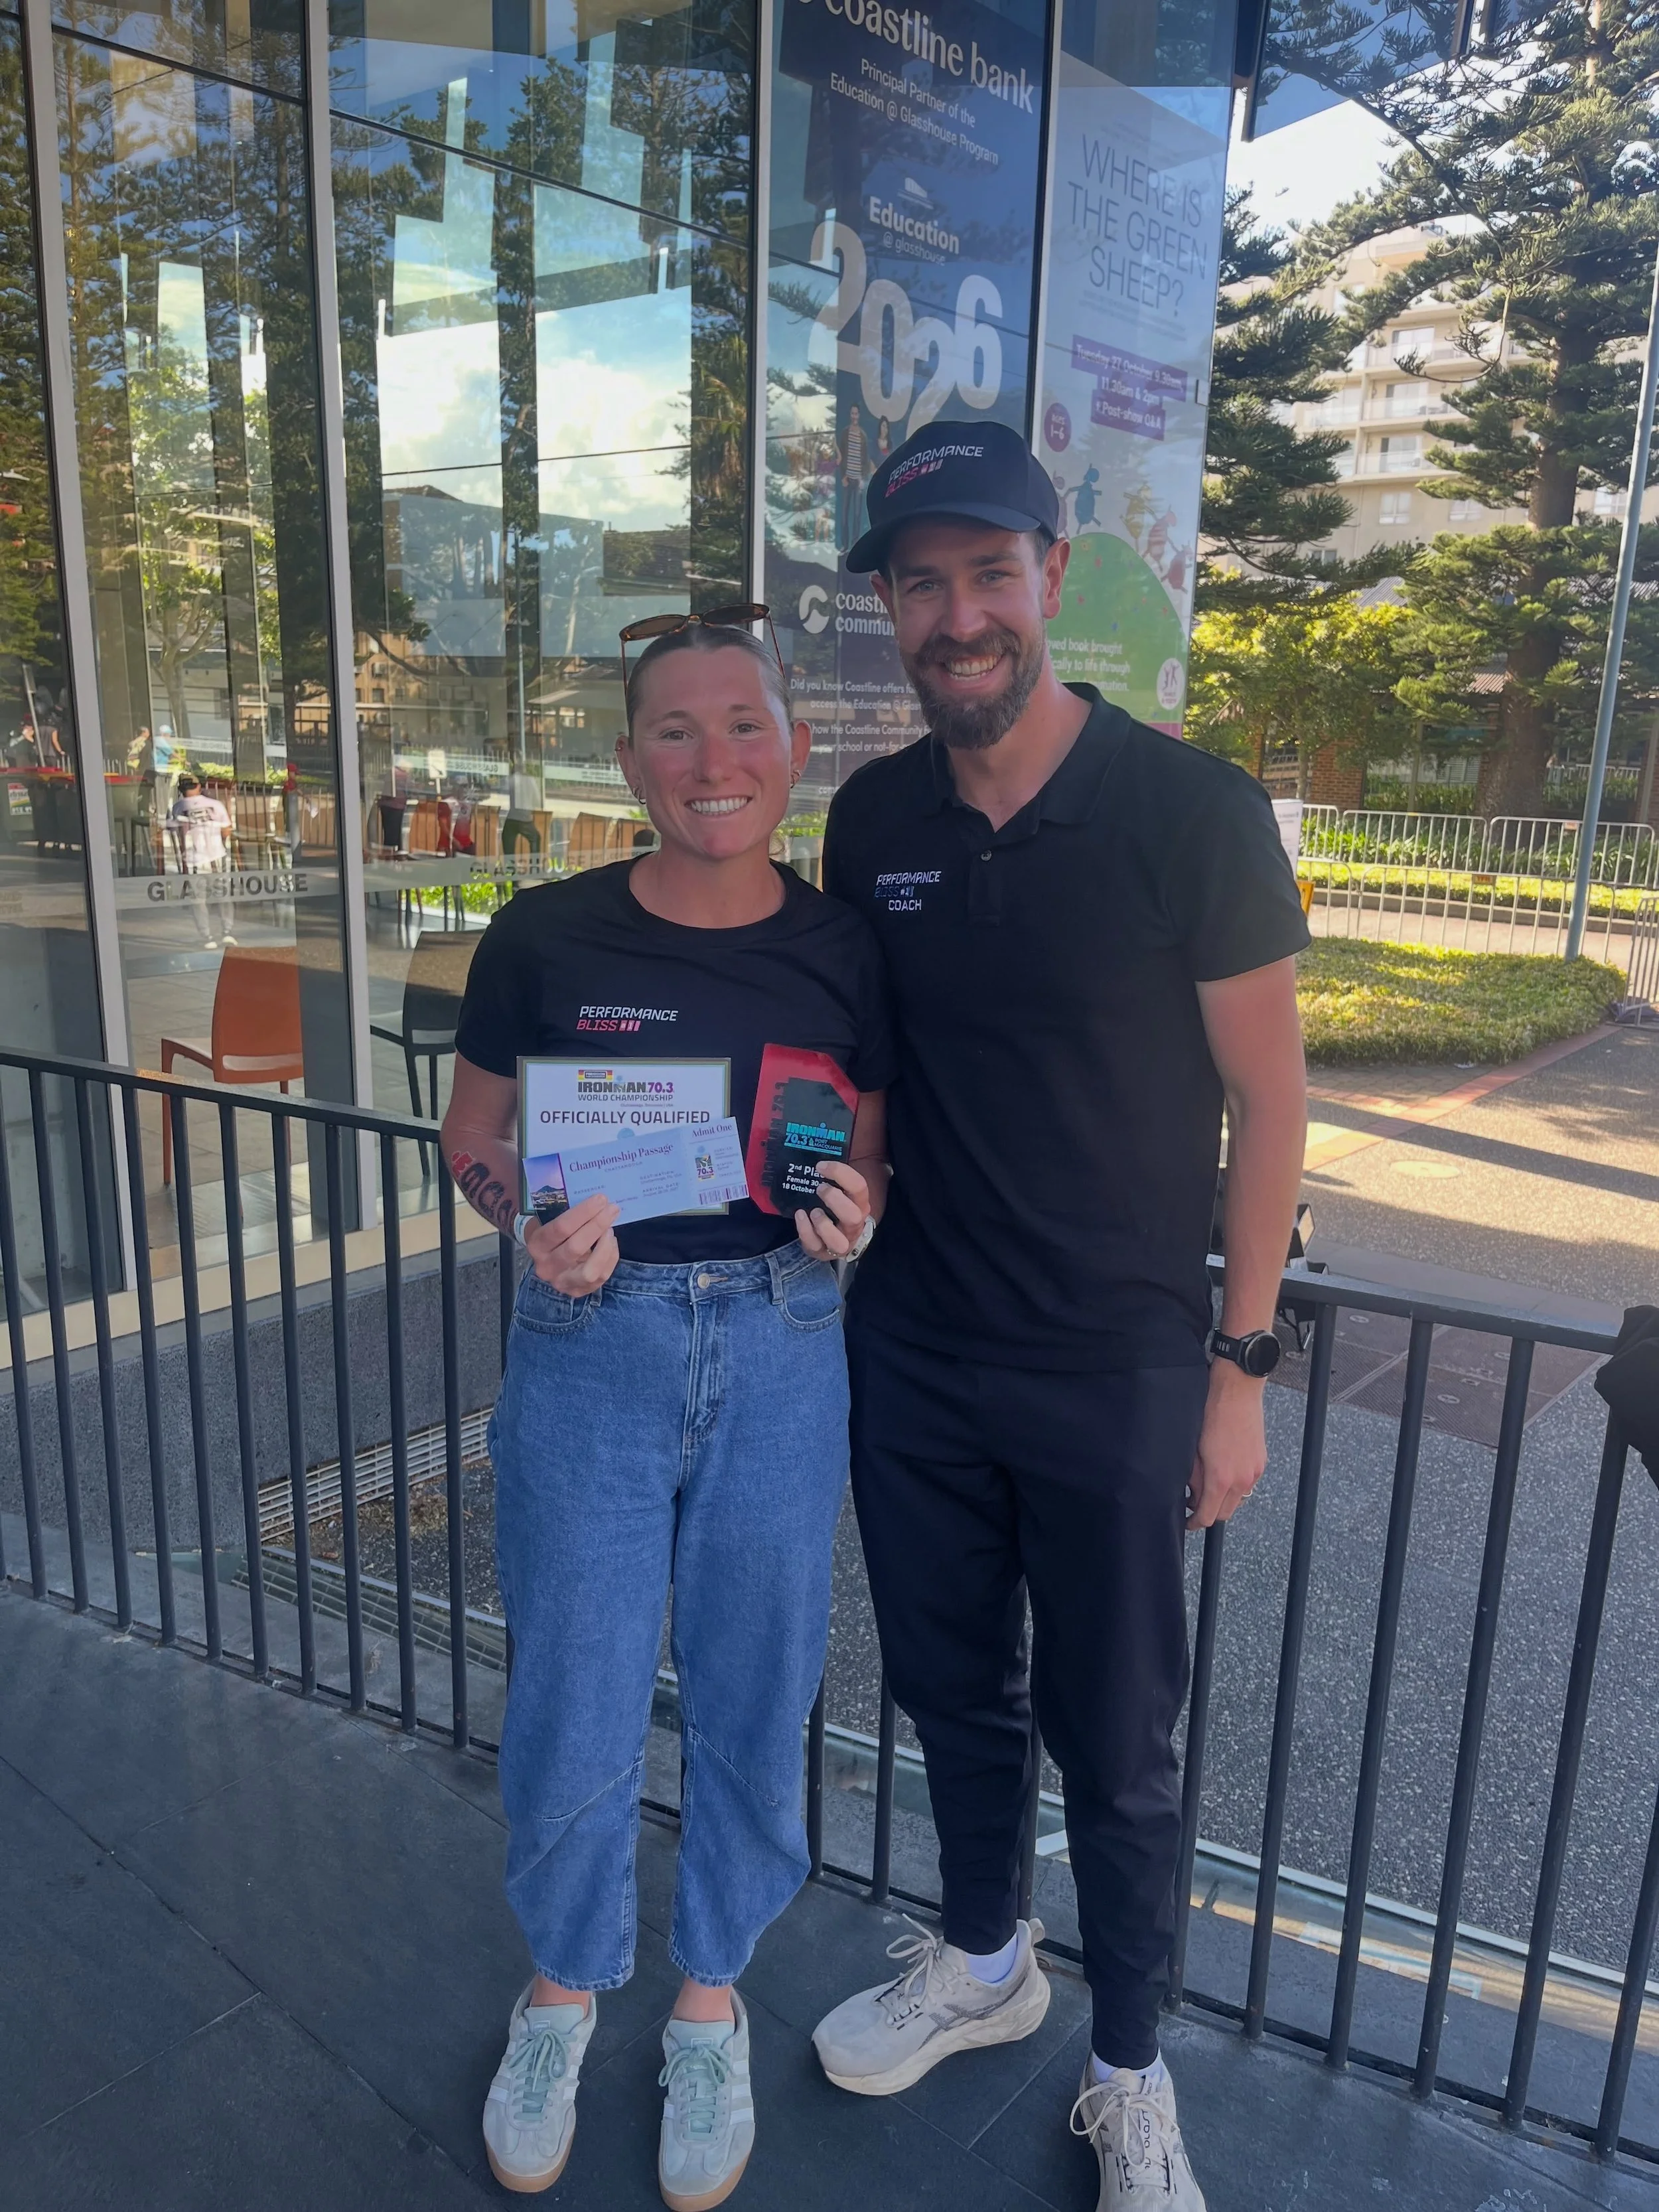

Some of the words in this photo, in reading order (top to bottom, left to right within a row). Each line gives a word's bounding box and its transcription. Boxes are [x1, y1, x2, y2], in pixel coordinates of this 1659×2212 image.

[970, 41, 1033, 114] bank
[861, 58, 907, 94] Principal
[909, 81, 946, 113] Partner
[948, 102, 958, 119] of
[960, 106, 975, 128] the
[830, 72, 884, 113] Education
[887, 101, 898, 121] @
[900, 106, 957, 146] Glasshouse
[959, 133, 999, 165] Program
[1082, 133, 1176, 217] WHERE
[1183, 184, 1201, 228] IS
[869, 196, 960, 255] Education
[1067, 181, 1120, 243] THE
[1126, 210, 1207, 281] GREEN
[883, 231, 894, 249] @
[895, 236, 946, 266] glasshouse
[1089, 245, 1184, 317] SHEEP?
[808, 222, 1003, 439] 2026
[1076, 344, 1110, 368] Tuesday
[1111, 356, 1122, 370] 27
[1123, 360, 1153, 381] October
[1135, 386, 1141, 400] &
[1102, 400, 1143, 425] Post-show
[1144, 413, 1161, 430] Q&A
[888, 445, 984, 484] PERFORMANCE
[884, 467, 919, 498] BLISS
[1068, 638, 1090, 652] book
[1091, 638, 1123, 657] brought
[1074, 659, 1084, 671] to
[1084, 658, 1098, 672] life
[1100, 658, 1131, 676] through
[790, 678, 805, 690] Did
[806, 682, 822, 693] you
[822, 680, 844, 691] know
[845, 680, 881, 693] Coastline
[882, 685, 904, 694] offers
[810, 700, 837, 709] access
[838, 698, 853, 709] the
[853, 699, 892, 710] Education
[831, 724, 844, 735] the
[845, 723, 881, 735] Coastline
[881, 724, 922, 738] Community
[838, 741, 863, 752] school
[875, 870, 942, 886] PERFORMANCE
[147, 873, 309, 902] GLASSHOUSE
[888, 899, 922, 911] COACH
[579, 1005, 679, 1021] PERFORMANCE
[576, 1019, 618, 1031] BLISS
[578, 1081, 647, 1093] IRONMAN
[648, 1081, 674, 1094] 70.3
[540, 1110, 626, 1124] OFFICIALLY
[630, 1110, 711, 1126] QUALIFIED
[691, 1127, 714, 1138] Admit
[716, 1124, 733, 1133] One
[784, 1132, 808, 1146] 70.3
[786, 1122, 845, 1142] IRONMAN
[814, 1142, 843, 1152] MACQUARIE
[569, 1150, 637, 1173] Championship
[638, 1143, 674, 1158] Passage
[697, 1166, 714, 1176] 70.3
[788, 1163, 802, 1173] 2nd
[786, 1175, 810, 1185] Female
[790, 1183, 816, 1195] October
